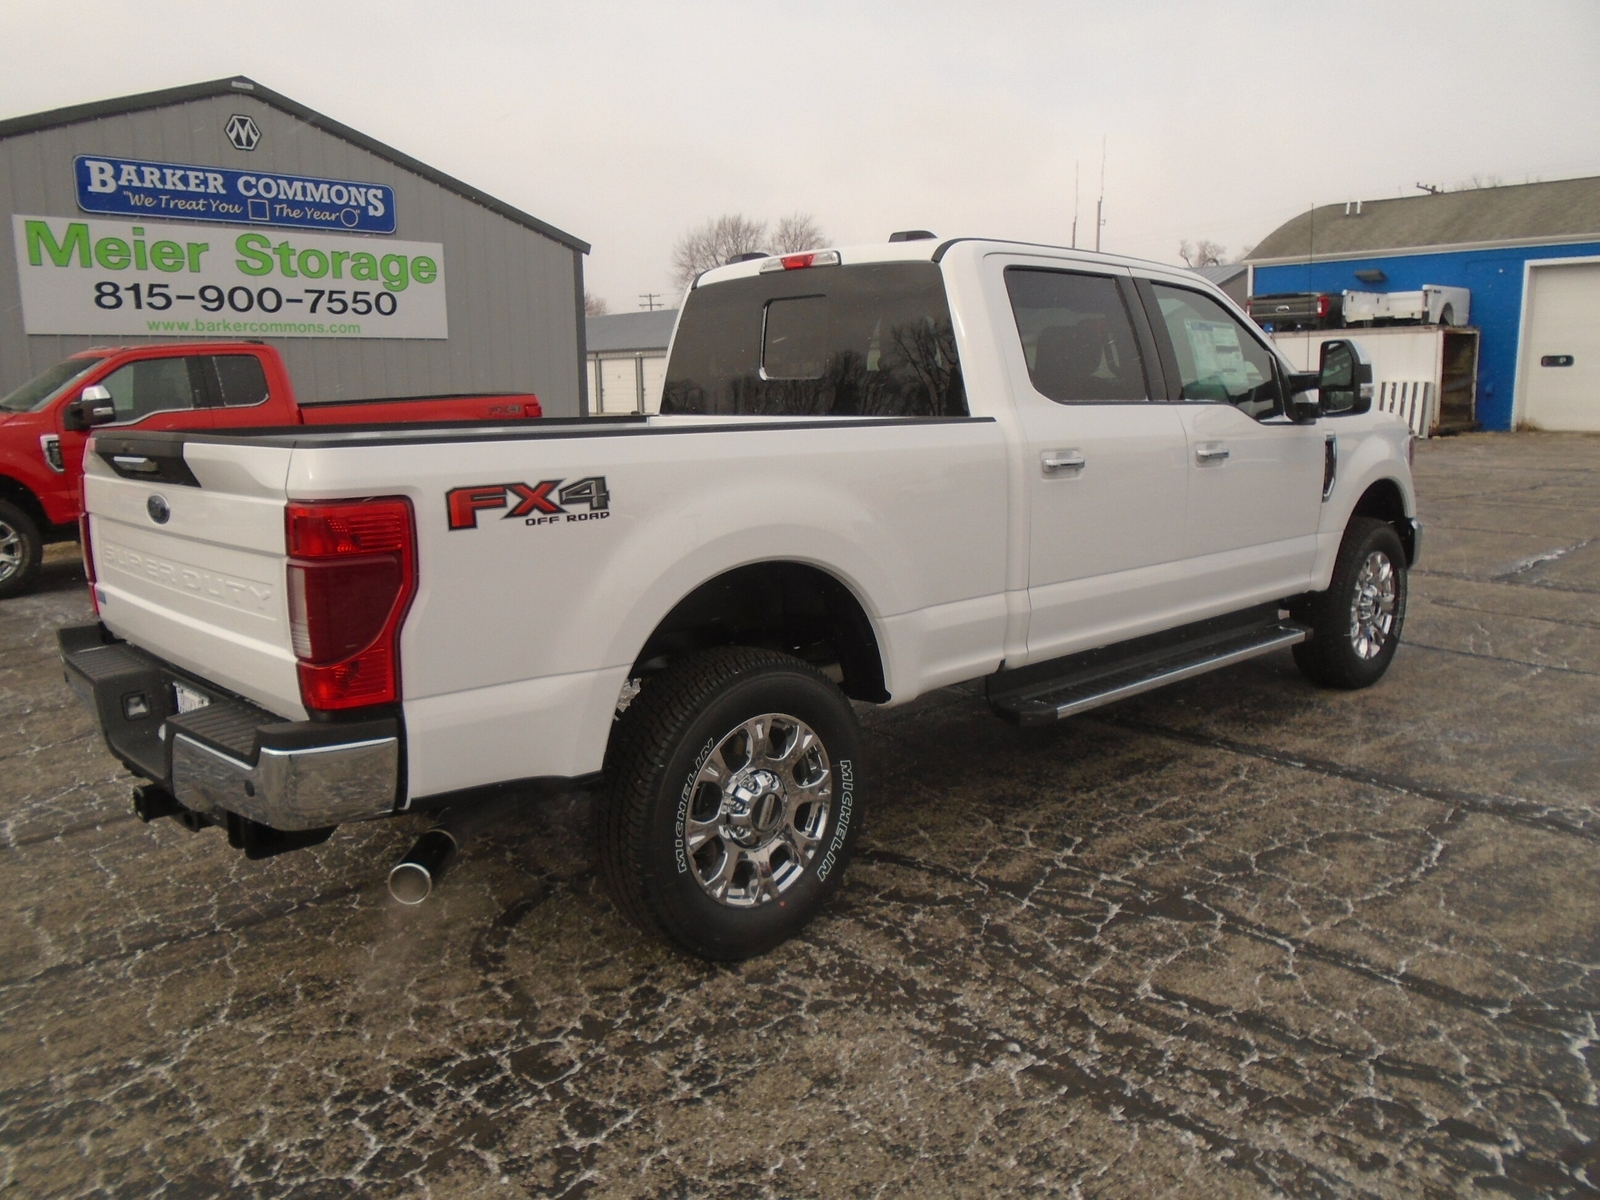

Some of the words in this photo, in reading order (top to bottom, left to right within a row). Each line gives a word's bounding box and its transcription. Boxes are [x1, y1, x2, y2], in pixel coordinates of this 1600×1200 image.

[85, 160, 226, 194] BARKER
[237, 176, 385, 217] COMMONS
[159, 195, 208, 211] Treat
[210, 199, 243, 213] You
[274, 204, 303, 219] The
[25, 220, 209, 273] Meier
[235, 232, 438, 292] Storage
[94, 281, 398, 316] 815-900-7550
[147, 318, 361, 334] www.barkercommons.com
[445, 476, 611, 532] FX4
[525, 516, 560, 526] OFF
[566, 511, 611, 523] ROAD
[103, 544, 177, 585] SUPER
[181, 568, 273, 611] DUTY
[675, 737, 714, 873] MICHELIN
[816, 759, 853, 882] MICHELIN
